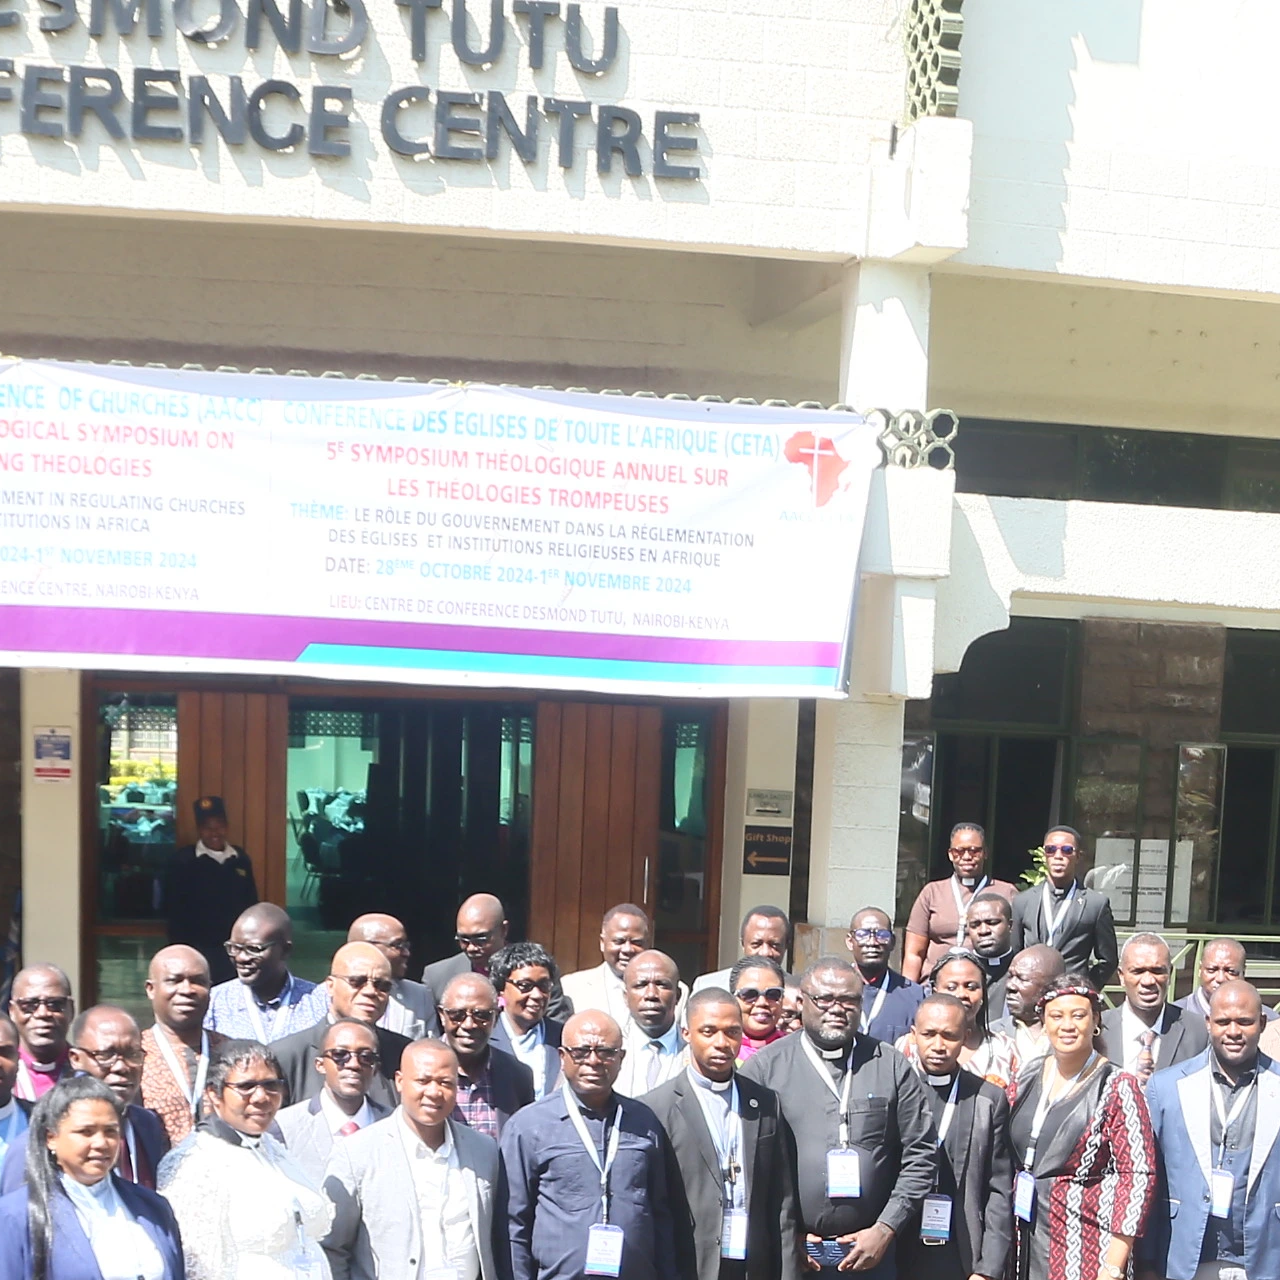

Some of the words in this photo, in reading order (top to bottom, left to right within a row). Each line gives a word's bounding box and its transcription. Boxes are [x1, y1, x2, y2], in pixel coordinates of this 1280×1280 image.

[394, 0, 620, 74] TUTU
[380, 86, 701, 180] CENTRE
[59, 386, 82, 411] OF
[89, 388, 189, 418] CHURCHES
[197, 394, 263, 425] (AACC)
[77, 423, 199, 448] SYMPOSIUM
[206, 430, 235, 450] ON
[284, 400, 406, 432] CONFERENCE
[412, 409, 448, 434] DES
[454, 411, 527, 440] EGLISES
[534, 417, 558, 442] DE
[565, 418, 620, 446] TOUTE
[723, 430, 780, 462] (CETA)
[31, 453, 153, 477] THEOLOGIES
[350, 443, 468, 468] SYMPOSIUM
[475, 448, 605, 479] THÉOLOGIQUE
[613, 462, 688, 484] ANNUEL
[694, 466, 728, 487] SUR
[49, 491, 64, 507] IN
[70, 492, 163, 512] REGULATING
[168, 496, 246, 516] CHURCHES
[387, 478, 419, 497] LES
[426, 478, 541, 505] THÉOLOGIES
[548, 488, 669, 514] TROMPEUSES
[76, 515, 90, 530] IN
[96, 516, 150, 533] AFRICA
[354, 508, 370, 522] LE
[375, 506, 411, 526] RÔLE
[417, 511, 436, 526] DU
[441, 512, 560, 535] GOUVERNEMENT
[565, 521, 604, 538] DANS
[609, 524, 627, 539] LA
[631, 523, 754, 548] RÉGLEMENTATION
[60, 548, 153, 568] NOVEMBER
[158, 552, 197, 568] 2024
[328, 528, 355, 544] DES
[361, 529, 418, 548] ÉGLISES
[427, 534, 443, 549] ET
[448, 535, 543, 556] INSTITUTIONS
[548, 542, 634, 562] RELIGIEUSES
[639, 548, 657, 563] EN
[662, 550, 721, 569] AFRIQUE
[37, 581, 92, 598] CENTRE,
[95, 583, 199, 602] NAIROBI-KENYA
[325, 556, 370, 574] DATE:
[420, 562, 492, 582] OCTOBRE
[564, 570, 650, 592] NOVEMBRE
[656, 577, 692, 594] 2024
[329, 594, 361, 610] LIEU:
[364, 596, 413, 613] CENTRE
[417, 598, 433, 614] DE
[437, 599, 519, 619] CONFERENCE
[523, 604, 587, 623] DESMOND
[590, 609, 627, 627] TUTU,
[632, 612, 730, 631] NAIROBI-KENYA
[745, 832, 764, 841] Gift
[766, 833, 792, 846] Shop
